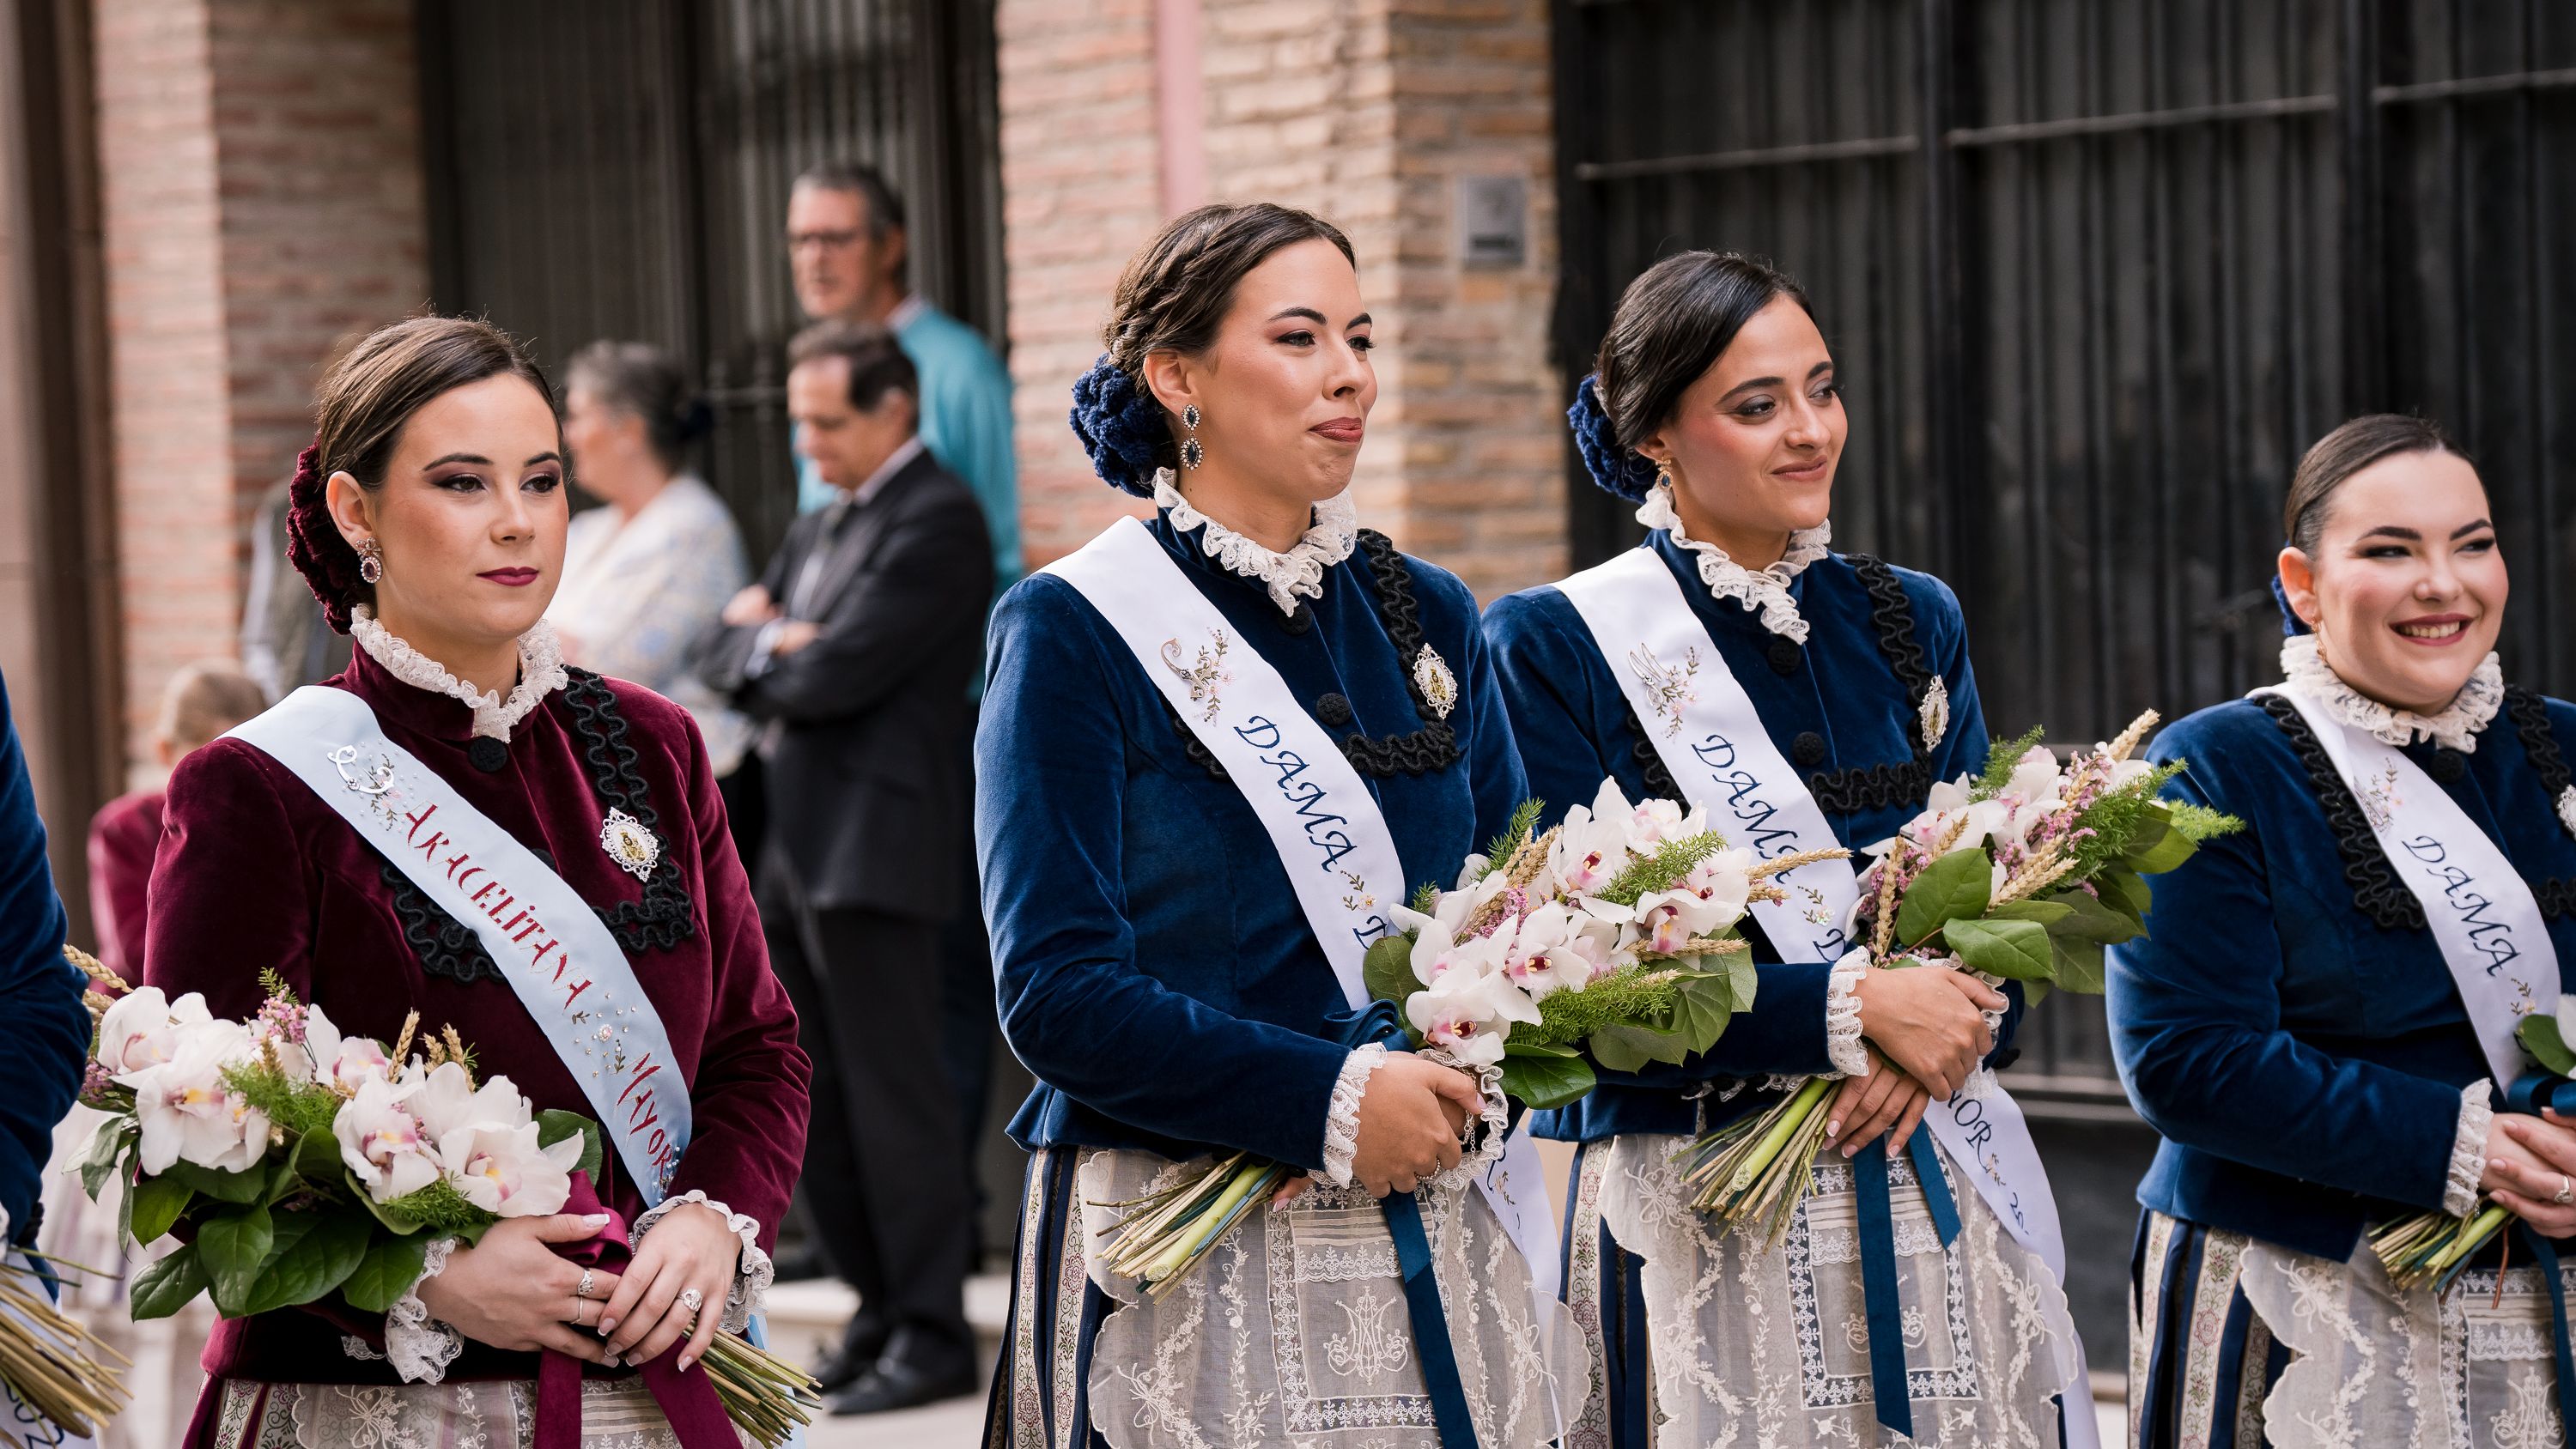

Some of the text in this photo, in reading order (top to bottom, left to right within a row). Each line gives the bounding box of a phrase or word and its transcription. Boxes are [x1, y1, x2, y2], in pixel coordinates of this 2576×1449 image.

[1234, 715, 1358, 873] DAMA
[2401, 835, 2521, 977] DAMA
[615, 1052, 674, 1185] MAYOR
